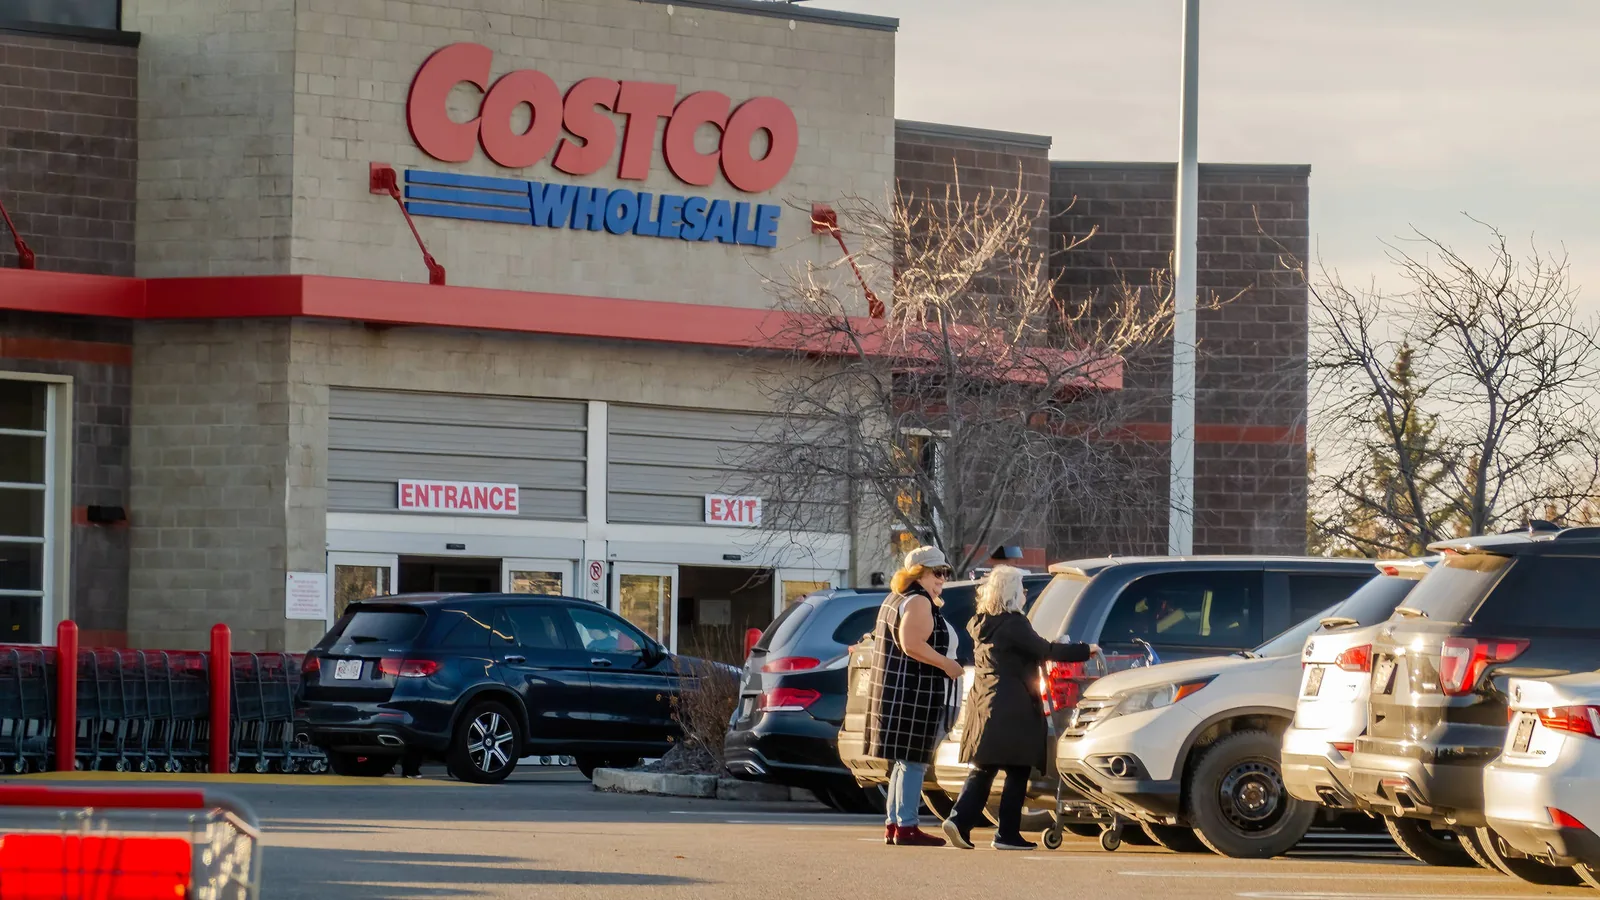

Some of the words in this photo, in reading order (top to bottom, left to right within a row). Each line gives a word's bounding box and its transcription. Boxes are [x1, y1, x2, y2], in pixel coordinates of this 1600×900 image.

[407, 42, 798, 193] COSTCO
[528, 181, 781, 248] WHOLESALE
[401, 483, 516, 511] ENTRANCE
[711, 498, 757, 523] EXIT
